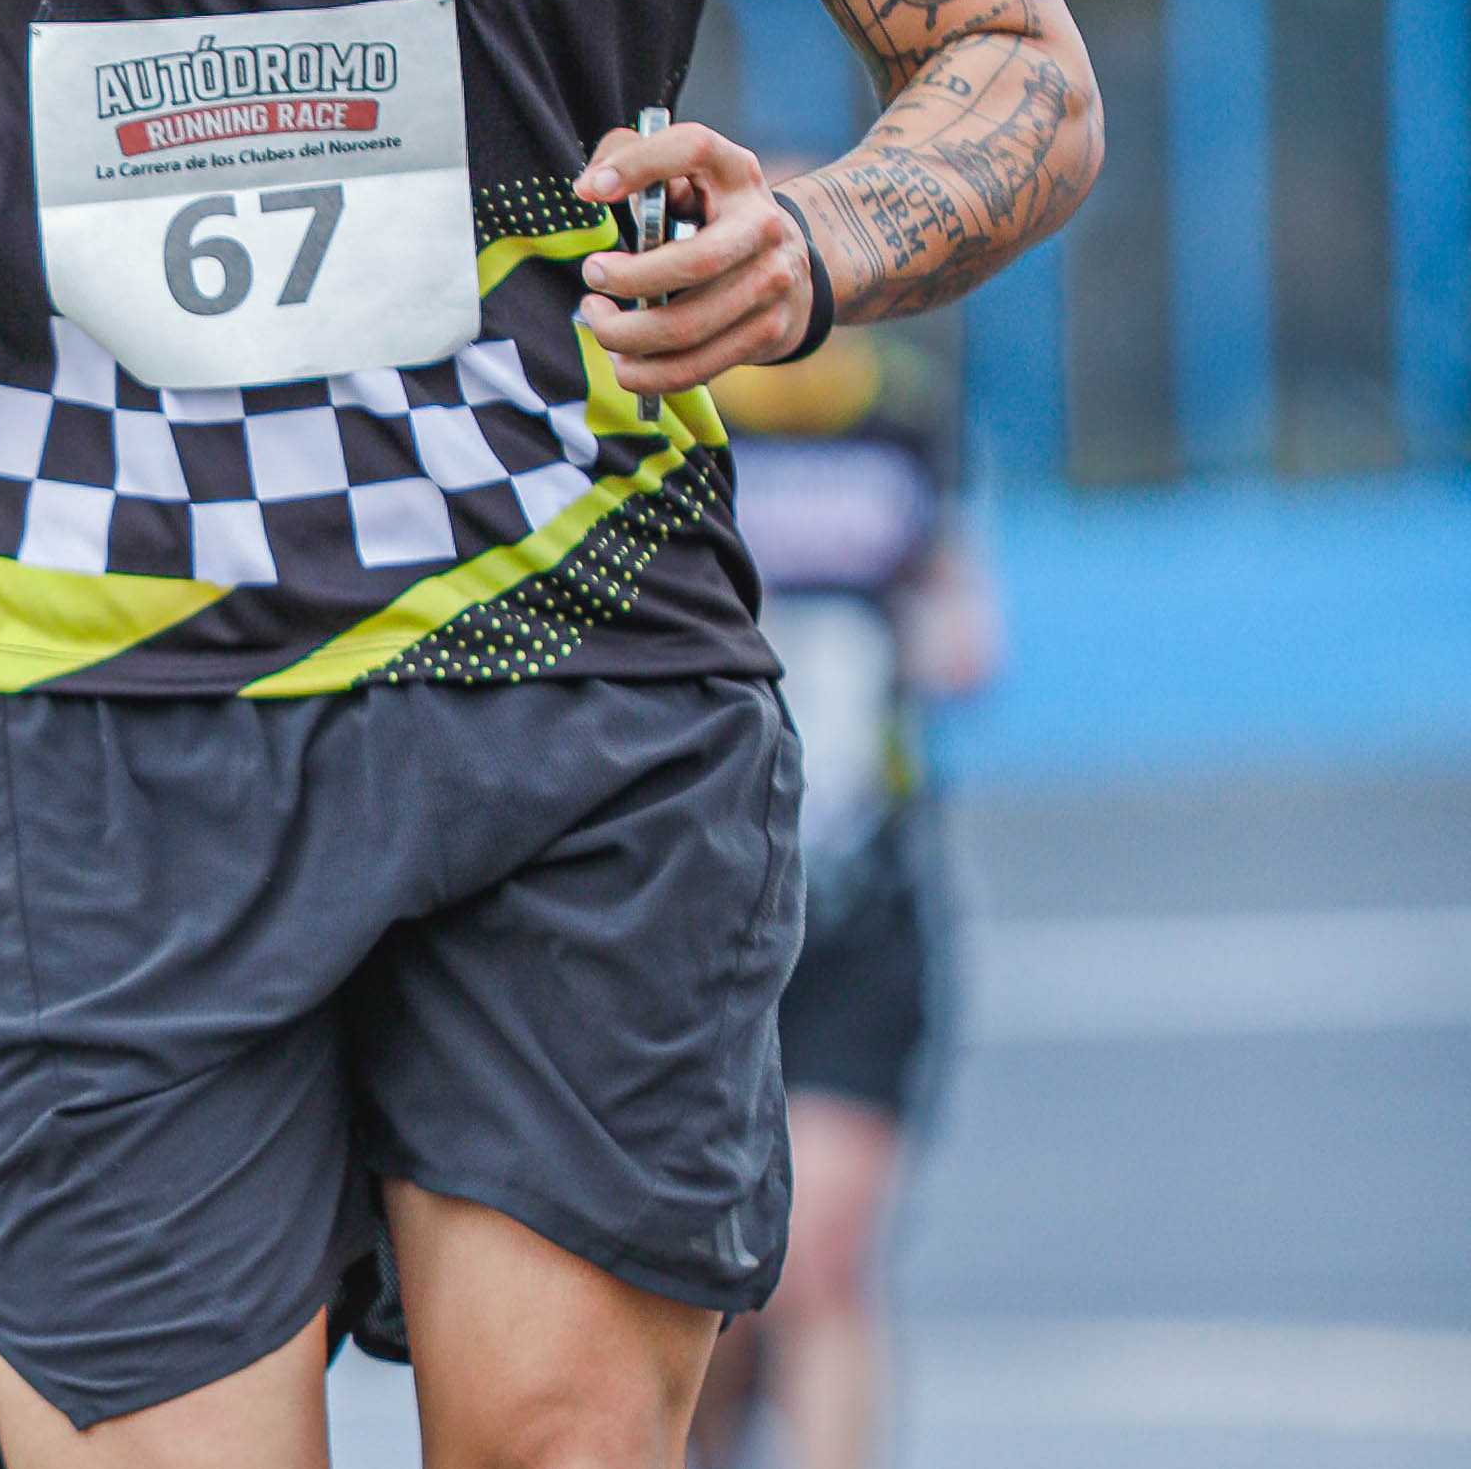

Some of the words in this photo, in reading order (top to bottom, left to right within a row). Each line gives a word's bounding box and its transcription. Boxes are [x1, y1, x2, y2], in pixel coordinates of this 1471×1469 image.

[95, 34, 397, 119] AUTÓDROMO
[95, 164, 115, 180] La
[119, 159, 182, 177] Carrera
[185, 154, 207, 170] de
[211, 152, 235, 168] los
[239, 146, 295, 165] Clubes
[299, 141, 325, 158] del
[329, 135, 402, 154] Noroeste
[144, 103, 269, 149] RUNNING
[277, 101, 349, 130] RACE
[844, 170, 911, 270] STEPS
[862, 164, 927, 256] FIRM
[887, 165, 942, 233] BUT
[163, 181, 346, 317] 67
